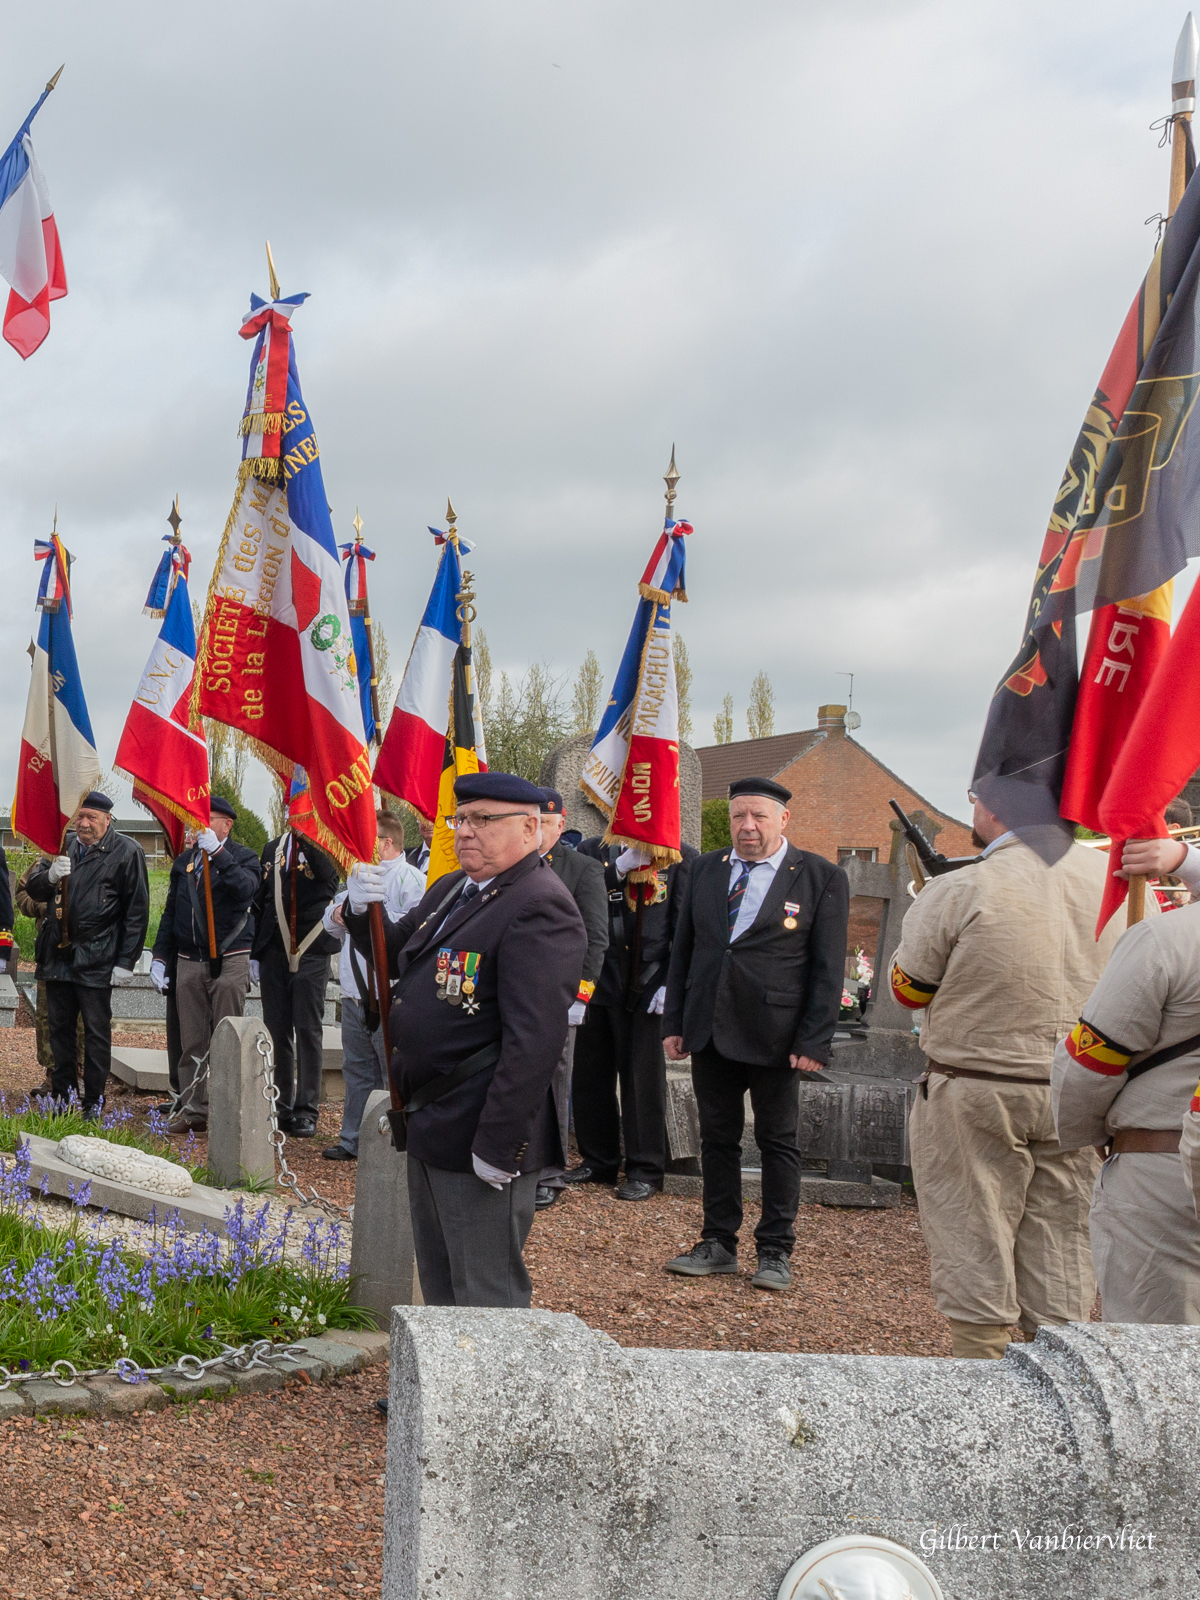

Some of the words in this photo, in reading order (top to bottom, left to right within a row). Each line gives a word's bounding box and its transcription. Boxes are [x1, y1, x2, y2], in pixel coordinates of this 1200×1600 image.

[206, 586, 246, 693] SOCIÉTÉ
[232, 523, 263, 572] des
[246, 543, 284, 638] LÉGION
[241, 652, 265, 676] la
[241, 689, 264, 720] de
[631, 762, 652, 823] UNION
